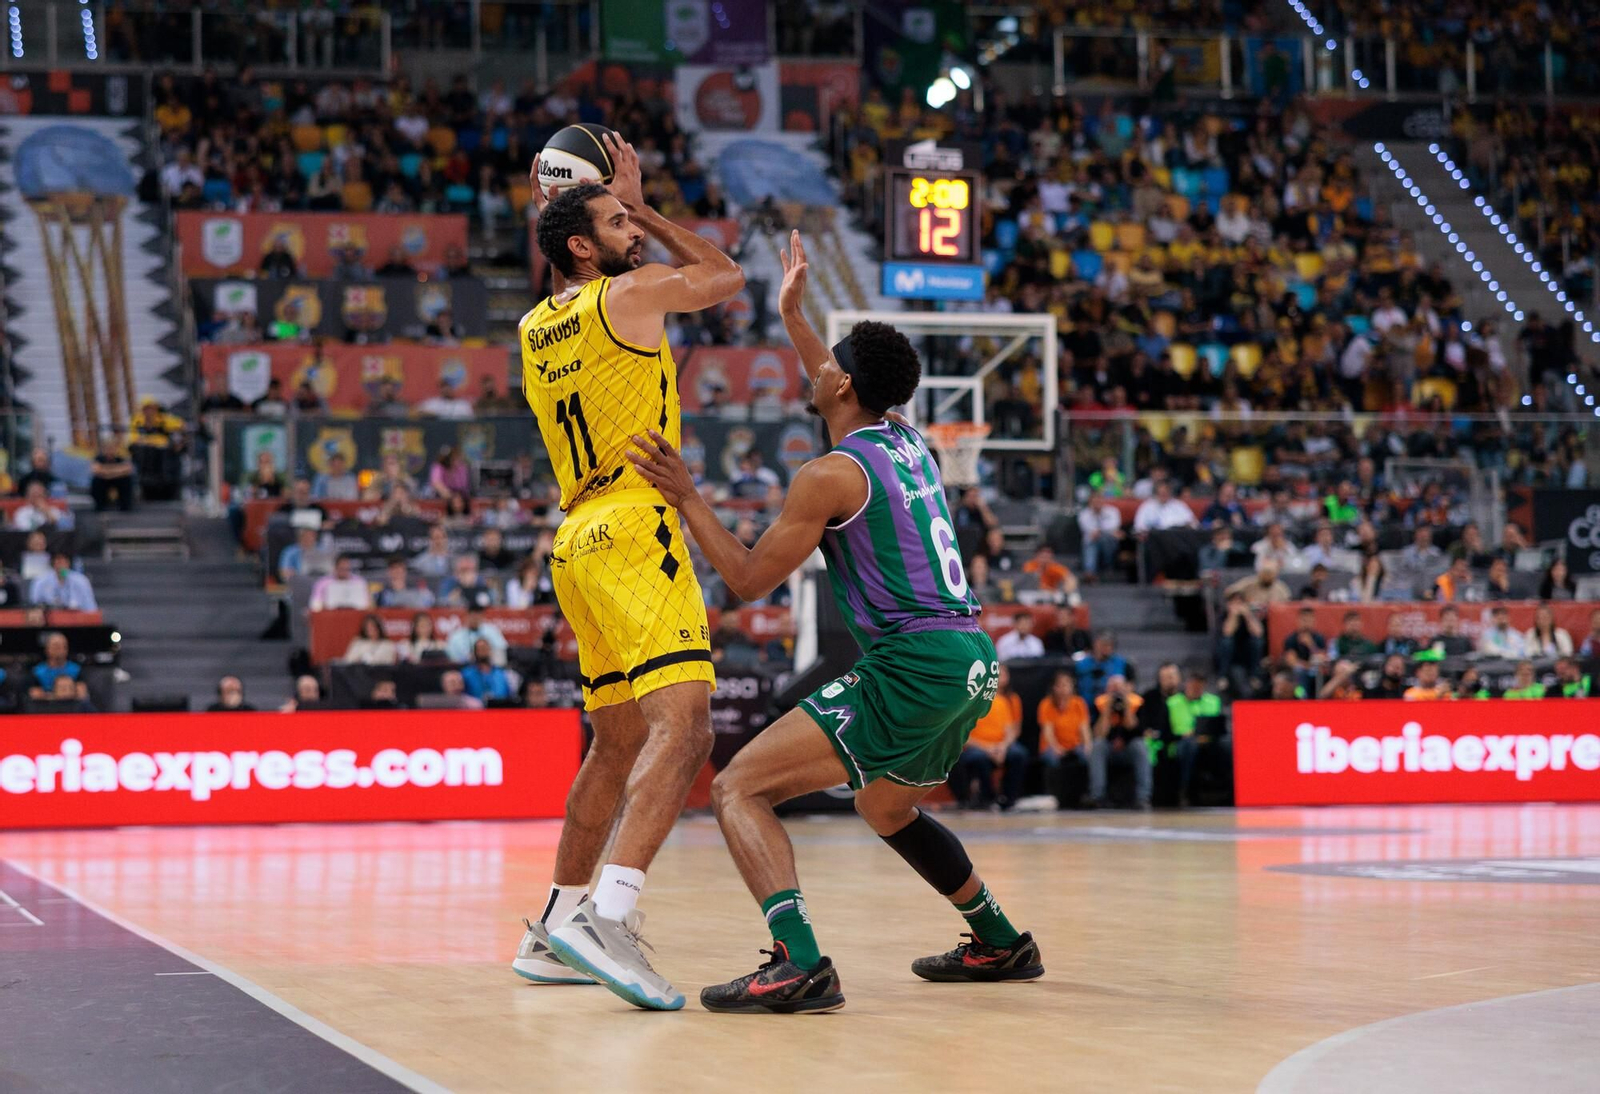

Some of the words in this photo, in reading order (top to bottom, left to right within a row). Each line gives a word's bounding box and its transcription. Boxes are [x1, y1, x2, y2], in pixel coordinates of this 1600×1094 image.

[537, 160, 573, 180] ilson
[919, 208, 961, 256] 12
[527, 311, 581, 353] SCRUBB
[556, 391, 598, 481] 11
[930, 516, 967, 598] 6
[0, 738, 503, 801] eriaexpress.com
[1295, 721, 1600, 781] iberiaexpre
